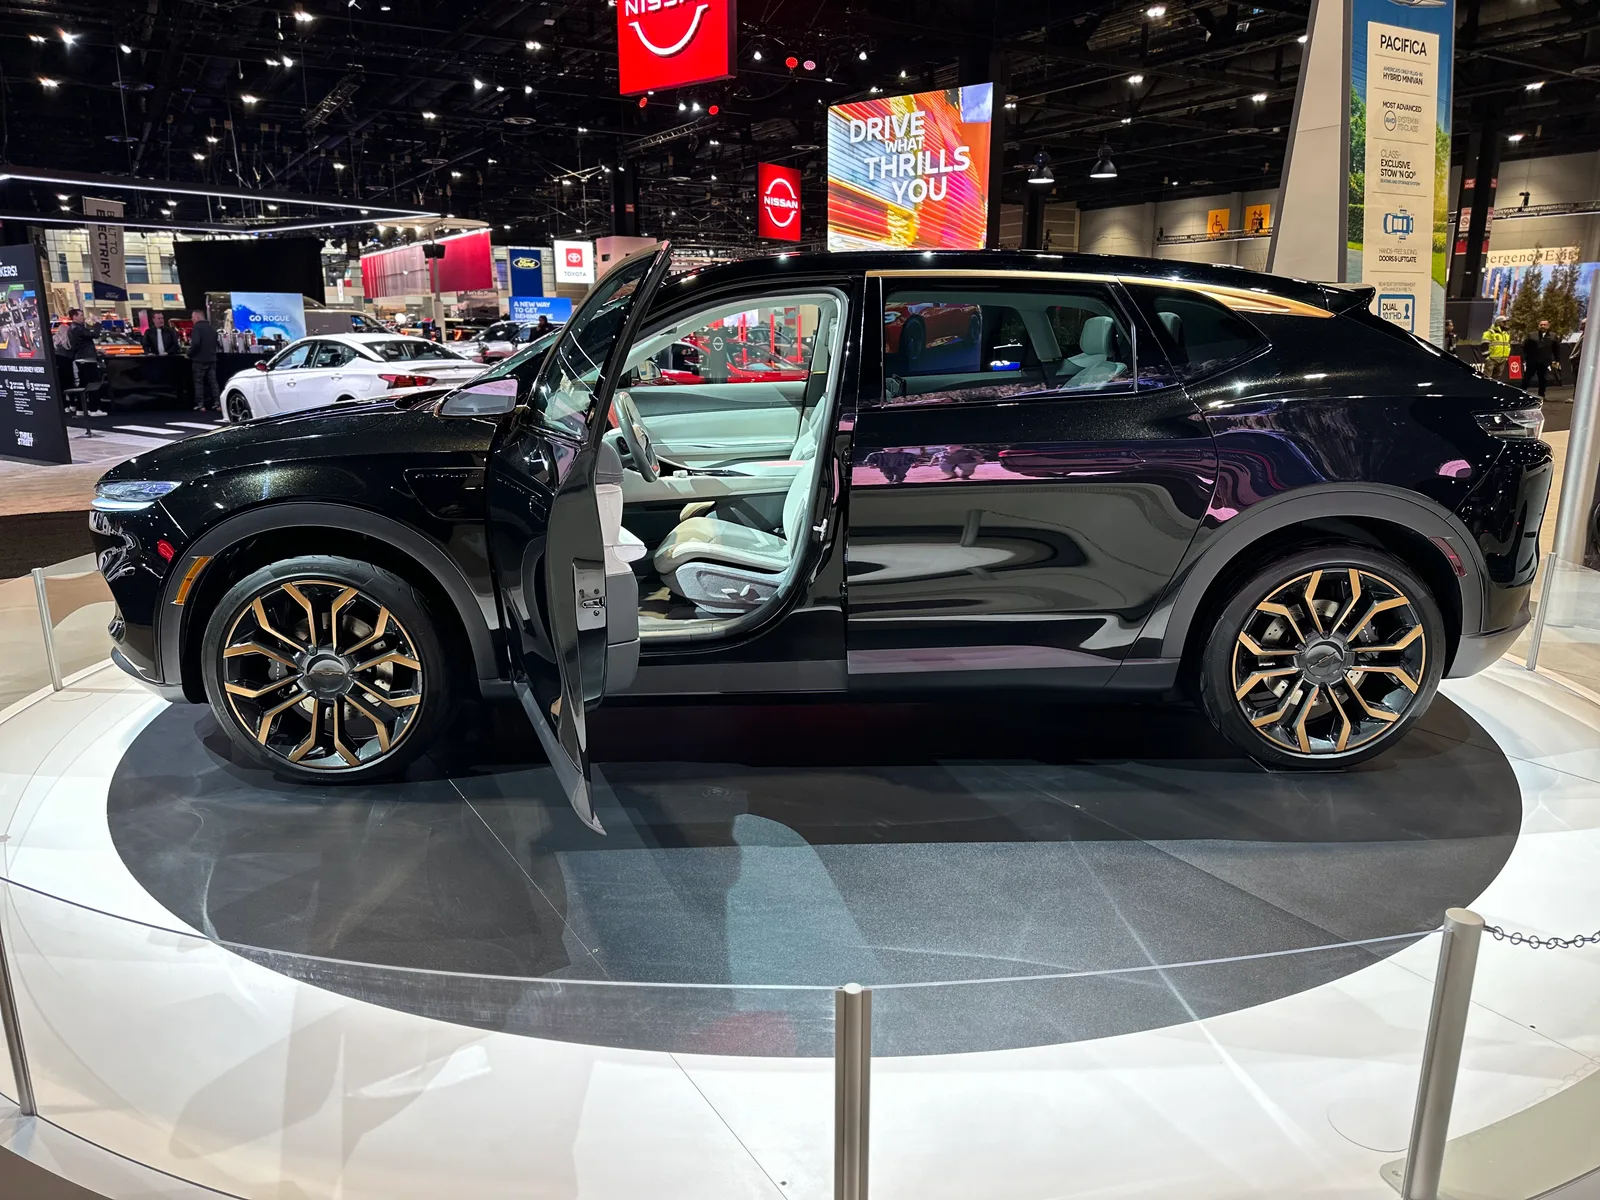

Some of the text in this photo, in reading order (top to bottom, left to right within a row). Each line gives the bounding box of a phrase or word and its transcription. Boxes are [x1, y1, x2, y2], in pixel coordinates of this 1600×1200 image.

[1380, 34, 1427, 56] PACIFICA
[1383, 72, 1423, 85] HYBRID MINIVAN
[1383, 101, 1422, 112] MOST ADVANCED
[850, 111, 925, 144] DRIVE
[885, 137, 925, 153] WHAT
[864, 146, 970, 180] THRILLS
[1381, 159, 1411, 169] EXCLUSIVE
[1381, 168, 1398, 178] STOW
[892, 176, 947, 204] YOU
[764, 196, 798, 209] NISSAN
[106, 210, 118, 255] BILT TO
[96, 208, 112, 278] EECTRIFY
[518, 258, 536, 268] Ford
[1383, 303, 1397, 311] DUAL
[249, 314, 290, 322] GO ROGUE
